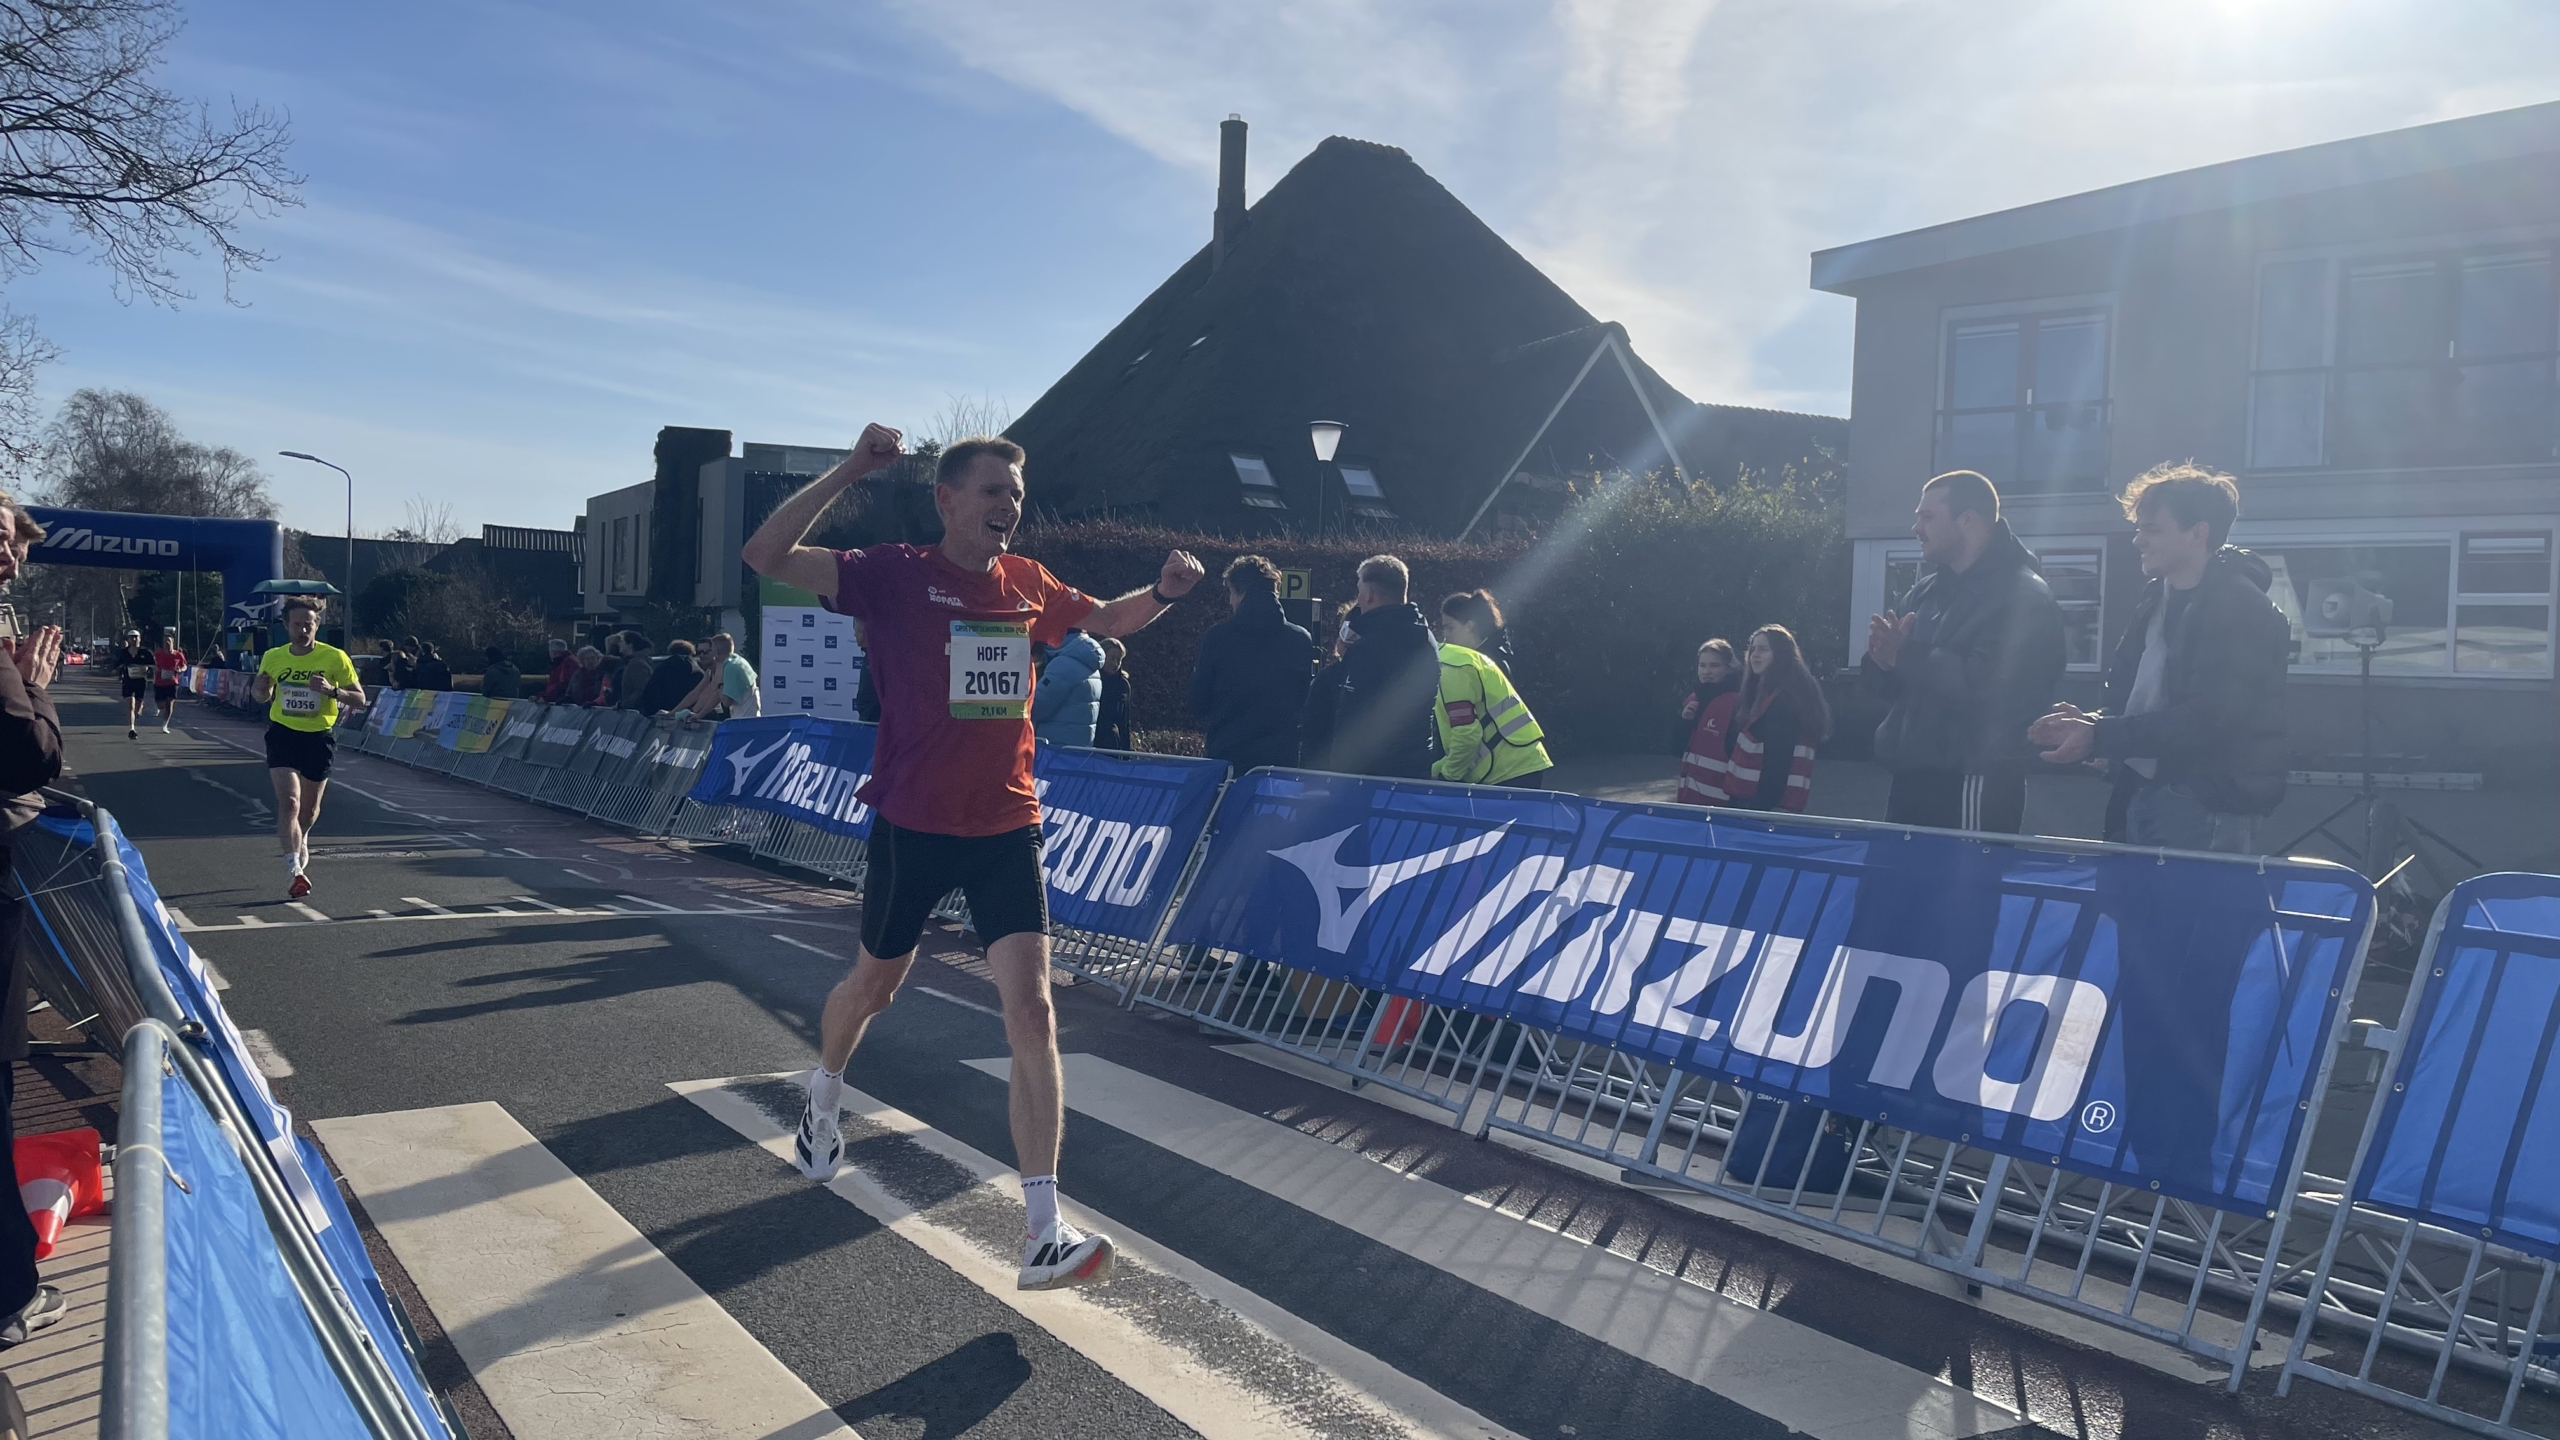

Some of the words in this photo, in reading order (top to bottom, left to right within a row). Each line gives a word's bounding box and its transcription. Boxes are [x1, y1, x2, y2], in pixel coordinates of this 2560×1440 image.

[43, 527, 179, 557] MIZUNO
[1287, 574, 1303, 598] P
[977, 646, 1008, 662] HOFF
[965, 671, 1020, 695] 20167
[996, 706, 1007, 716] KM
[1410, 855, 2108, 1121] MIZUNO
